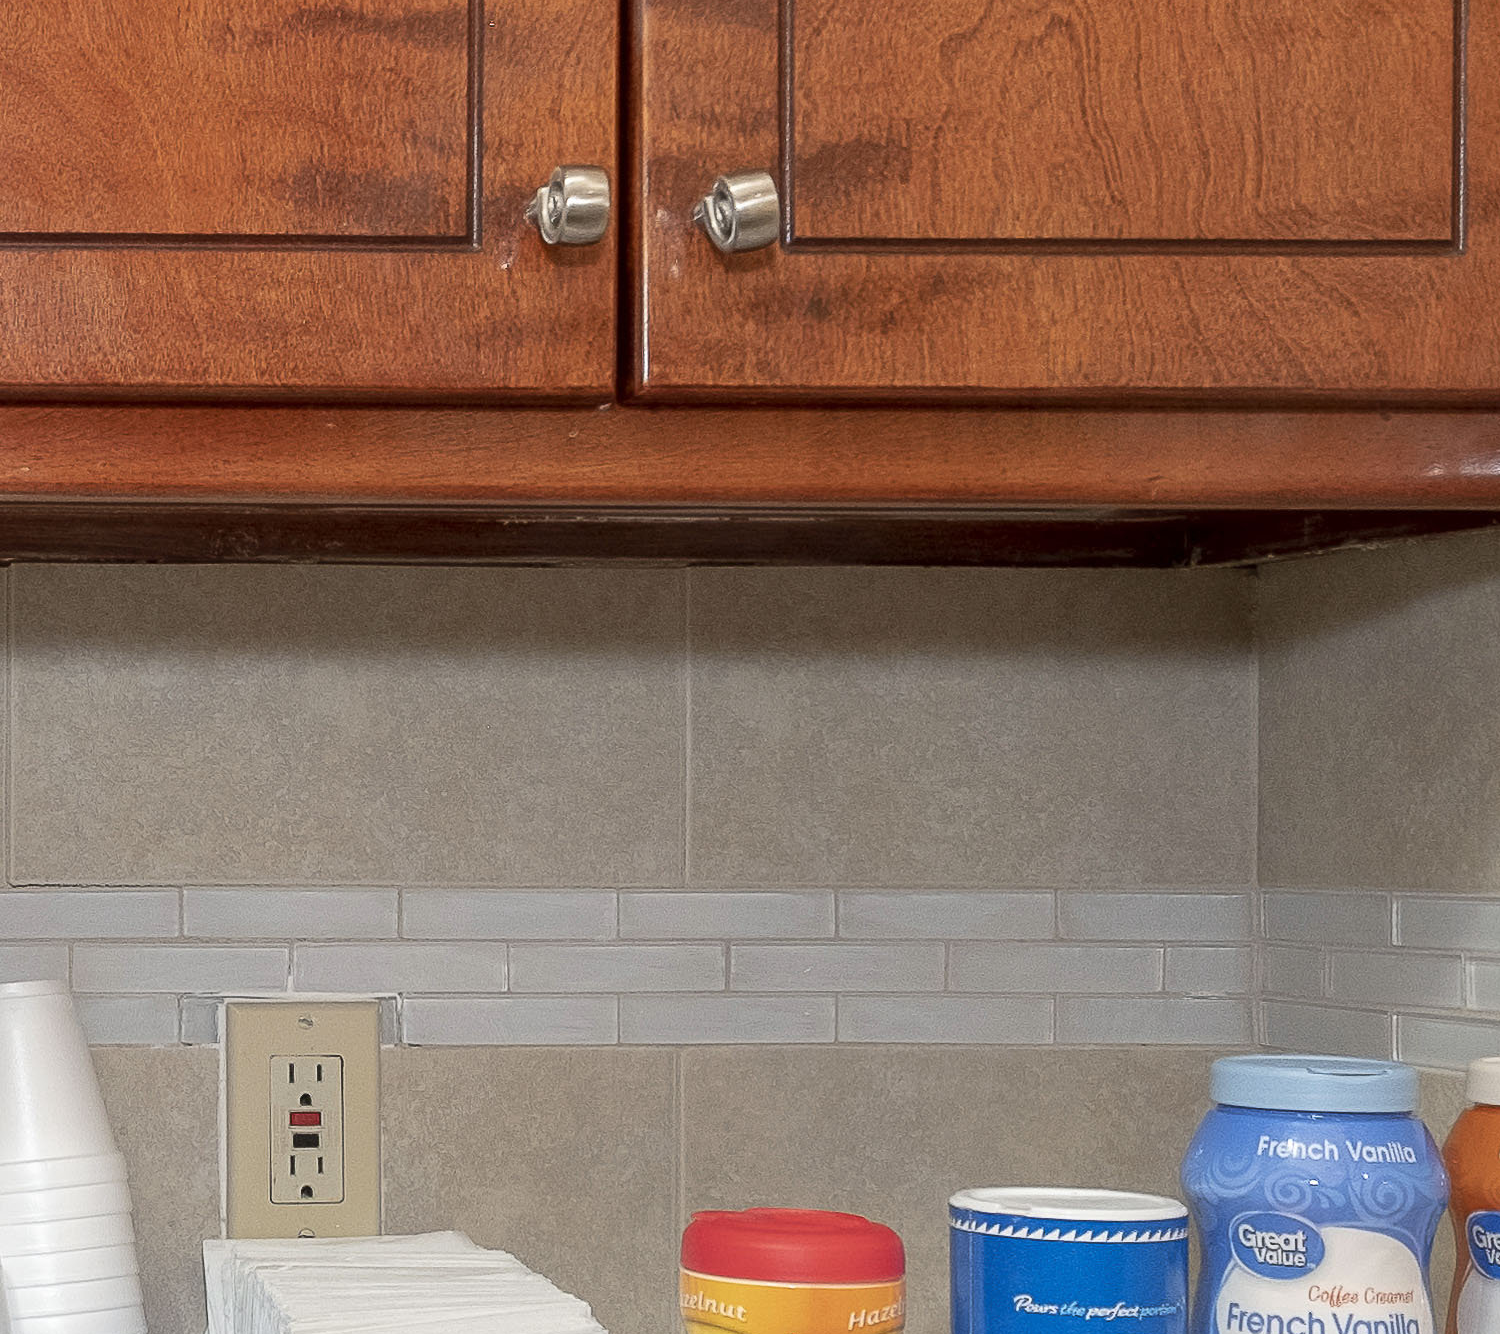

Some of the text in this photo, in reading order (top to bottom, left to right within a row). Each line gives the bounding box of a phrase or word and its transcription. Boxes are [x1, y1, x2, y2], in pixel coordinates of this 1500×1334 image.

[1257, 1136, 1417, 1164] French Vanilla
[1238, 1223, 1307, 1254] Great
[1254, 1247, 1306, 1267] Value
[1013, 1294, 1059, 1316] Pours
[1060, 1301, 1086, 1317] the
[1085, 1301, 1139, 1321] perfect
[1308, 1285, 1414, 1307] Coffee Creamer
